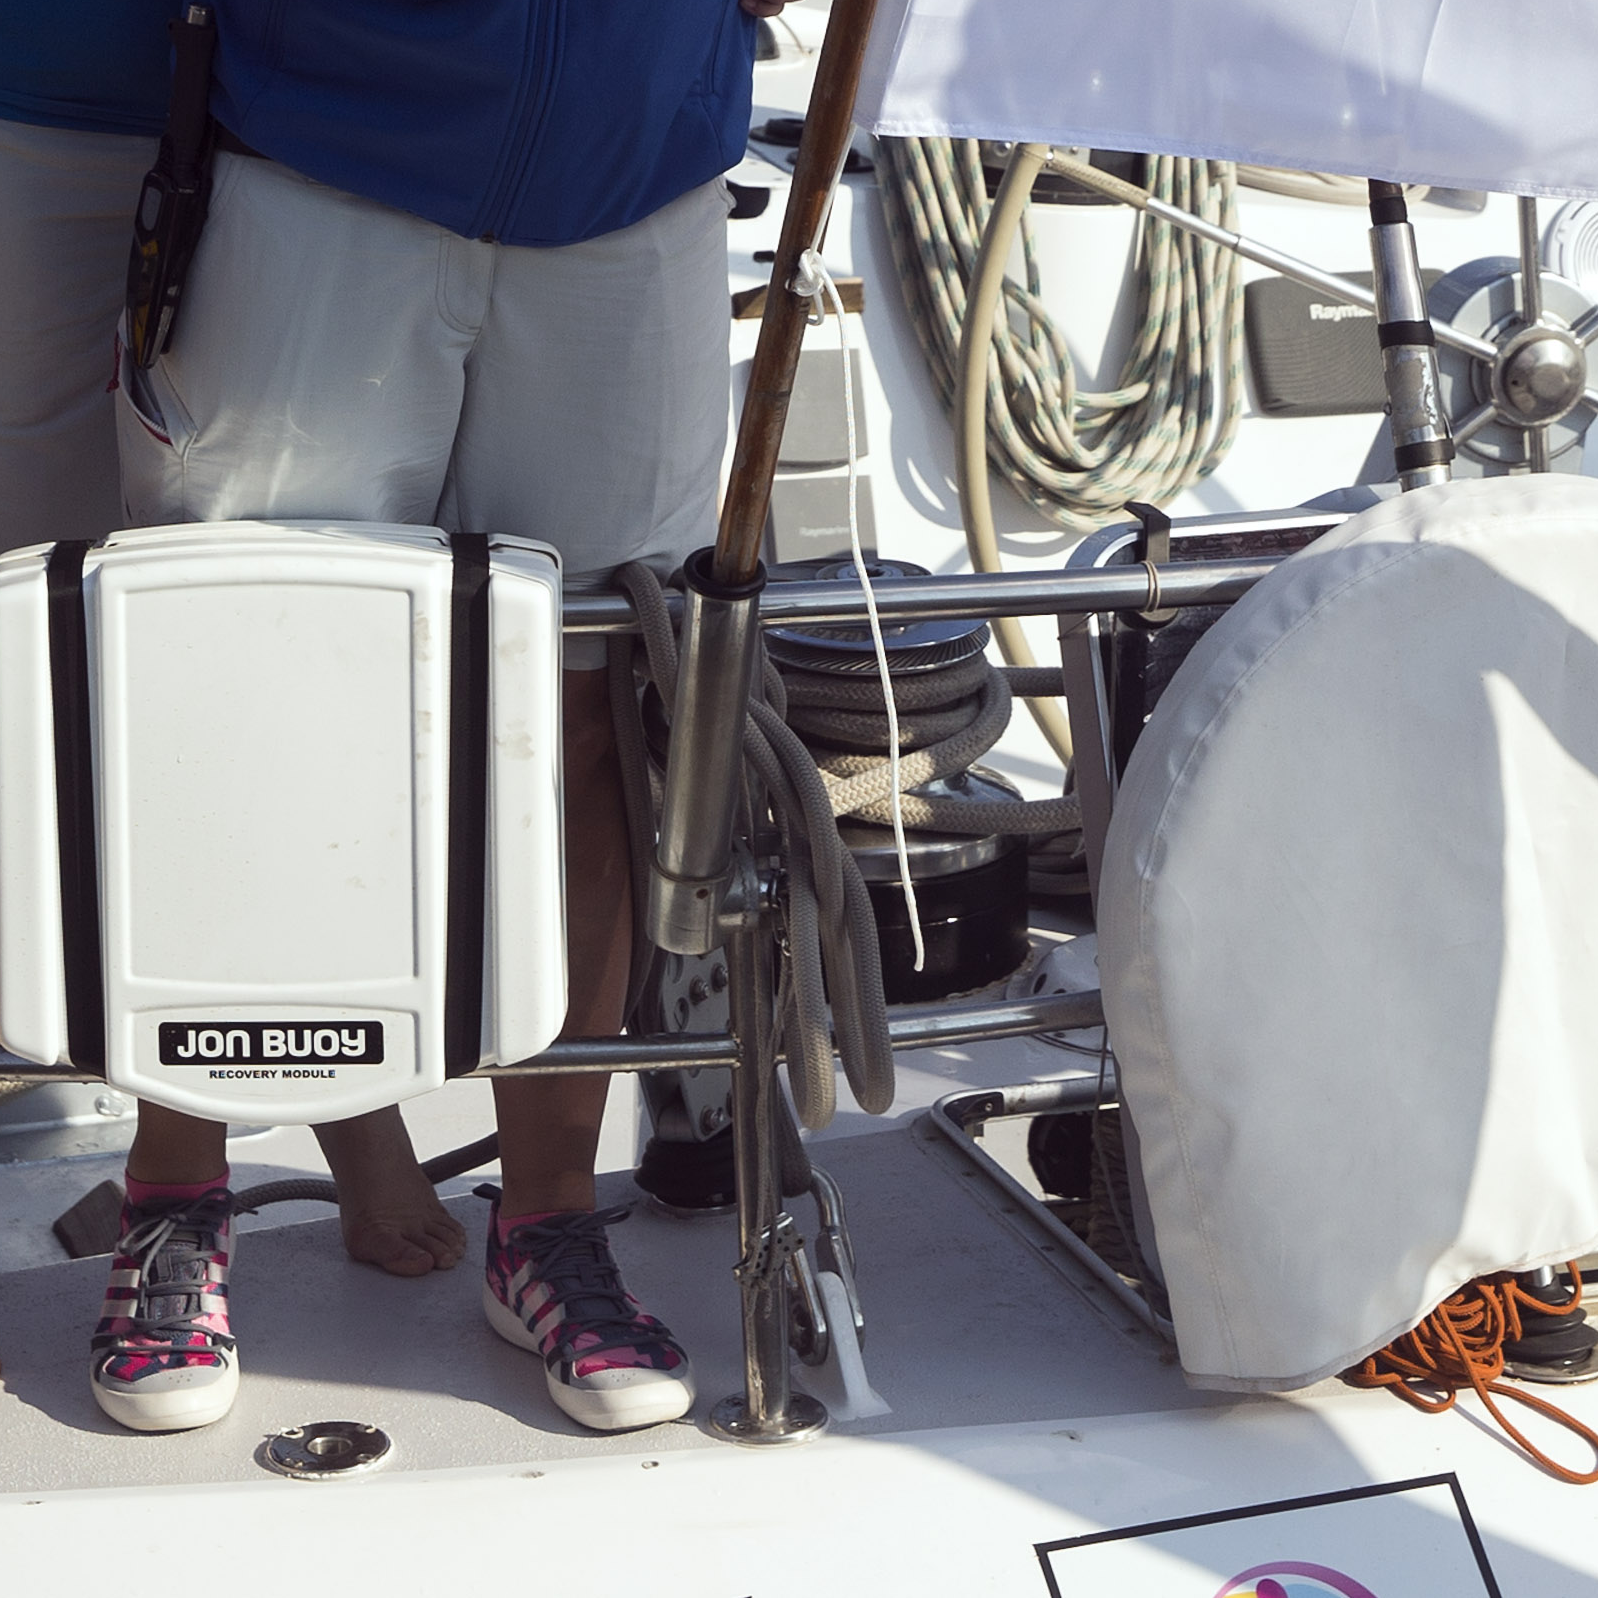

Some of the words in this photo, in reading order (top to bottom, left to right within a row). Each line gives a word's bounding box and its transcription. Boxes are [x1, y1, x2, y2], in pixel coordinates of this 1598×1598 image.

[177, 1029, 251, 1058] JON
[261, 1028, 367, 1058] BUOY
[208, 1069, 278, 1080] RECOVERY
[282, 1069, 337, 1080] MODULE
